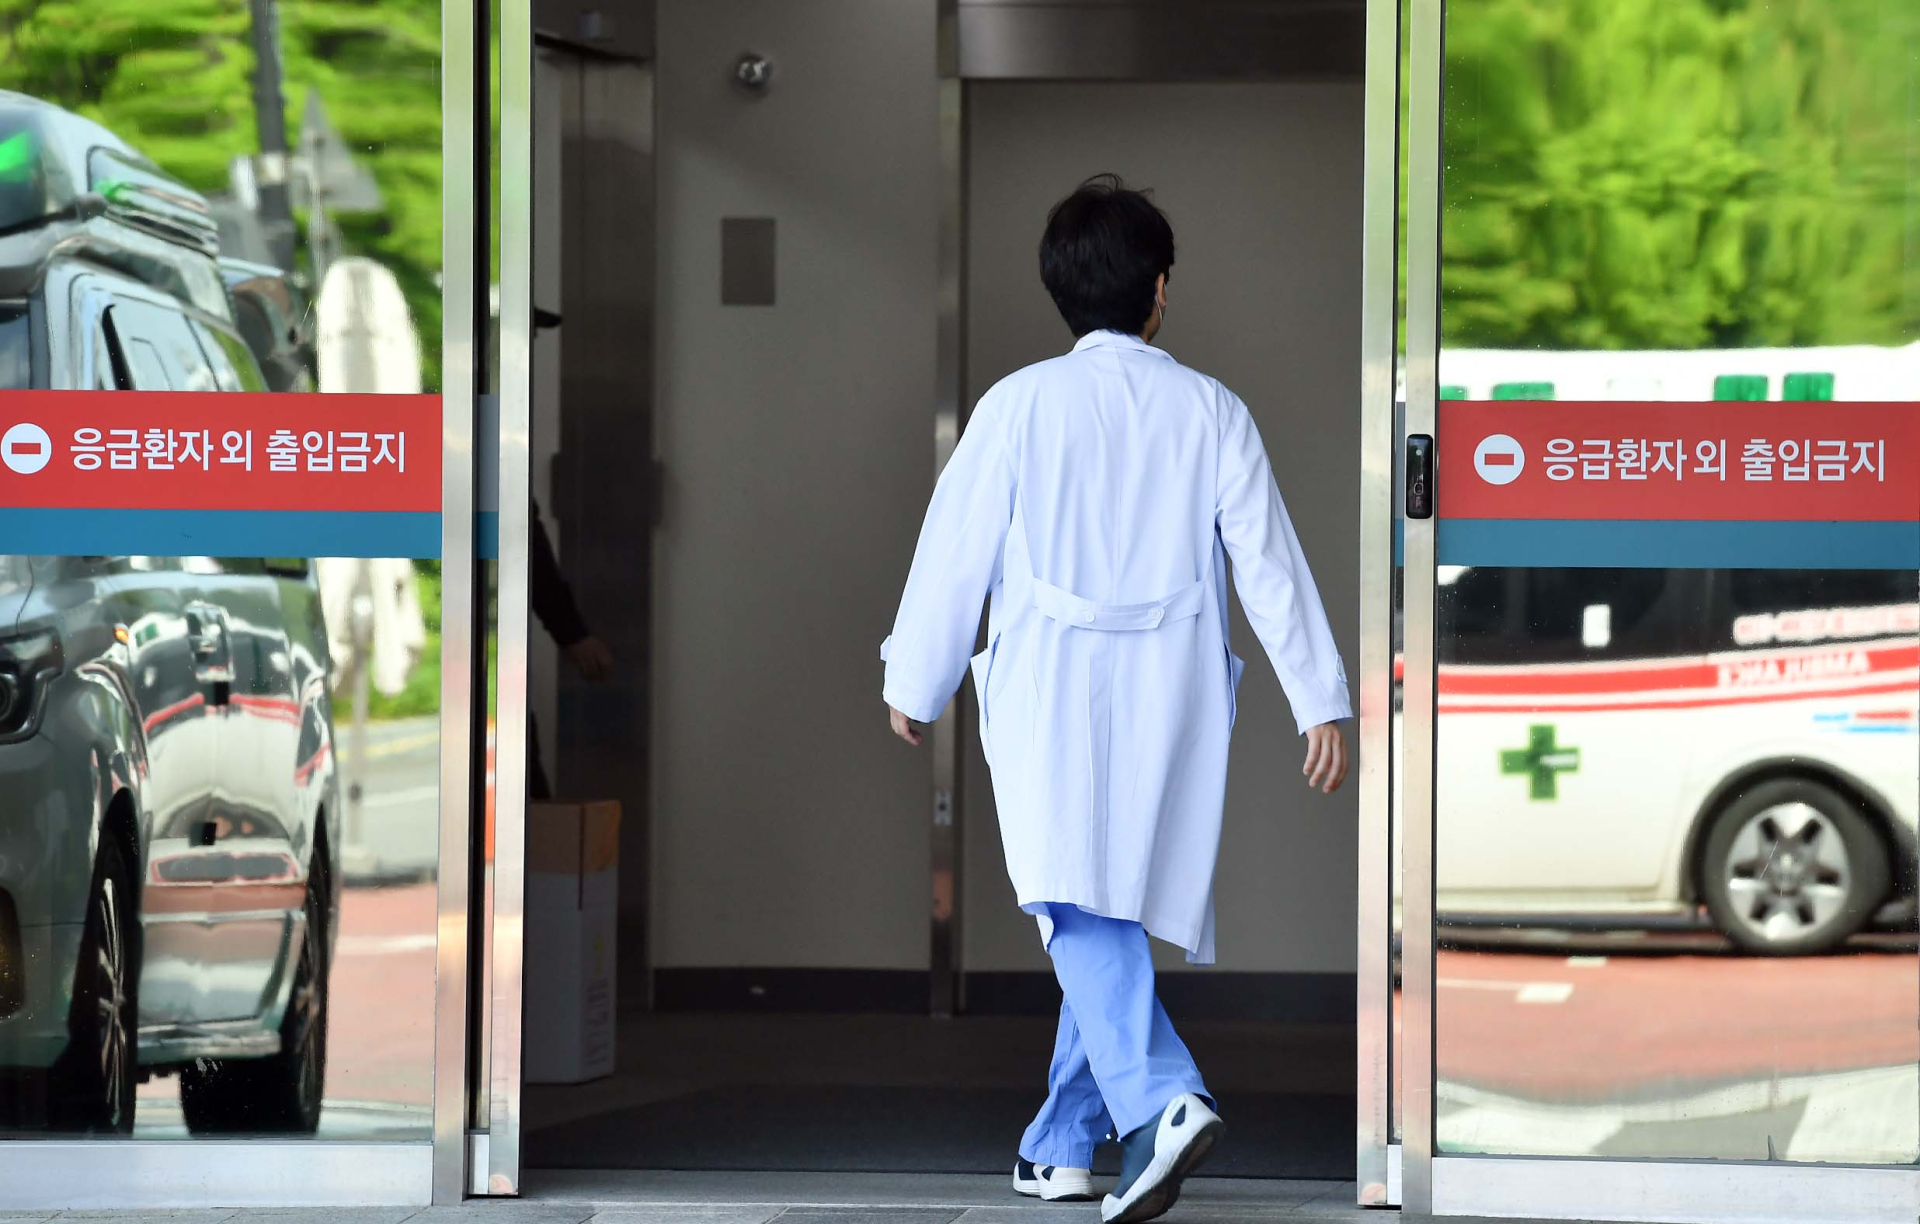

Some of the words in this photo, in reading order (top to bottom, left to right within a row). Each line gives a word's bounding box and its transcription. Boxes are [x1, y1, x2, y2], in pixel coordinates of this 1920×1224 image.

[70, 427, 214, 471] 응급환자
[219, 429, 252, 471] 외
[266, 429, 405, 473] 출입금지
[1542, 438, 1688, 481] 응급환자
[1693, 439, 1726, 482] 외
[1741, 438, 1885, 482] 출입금지
